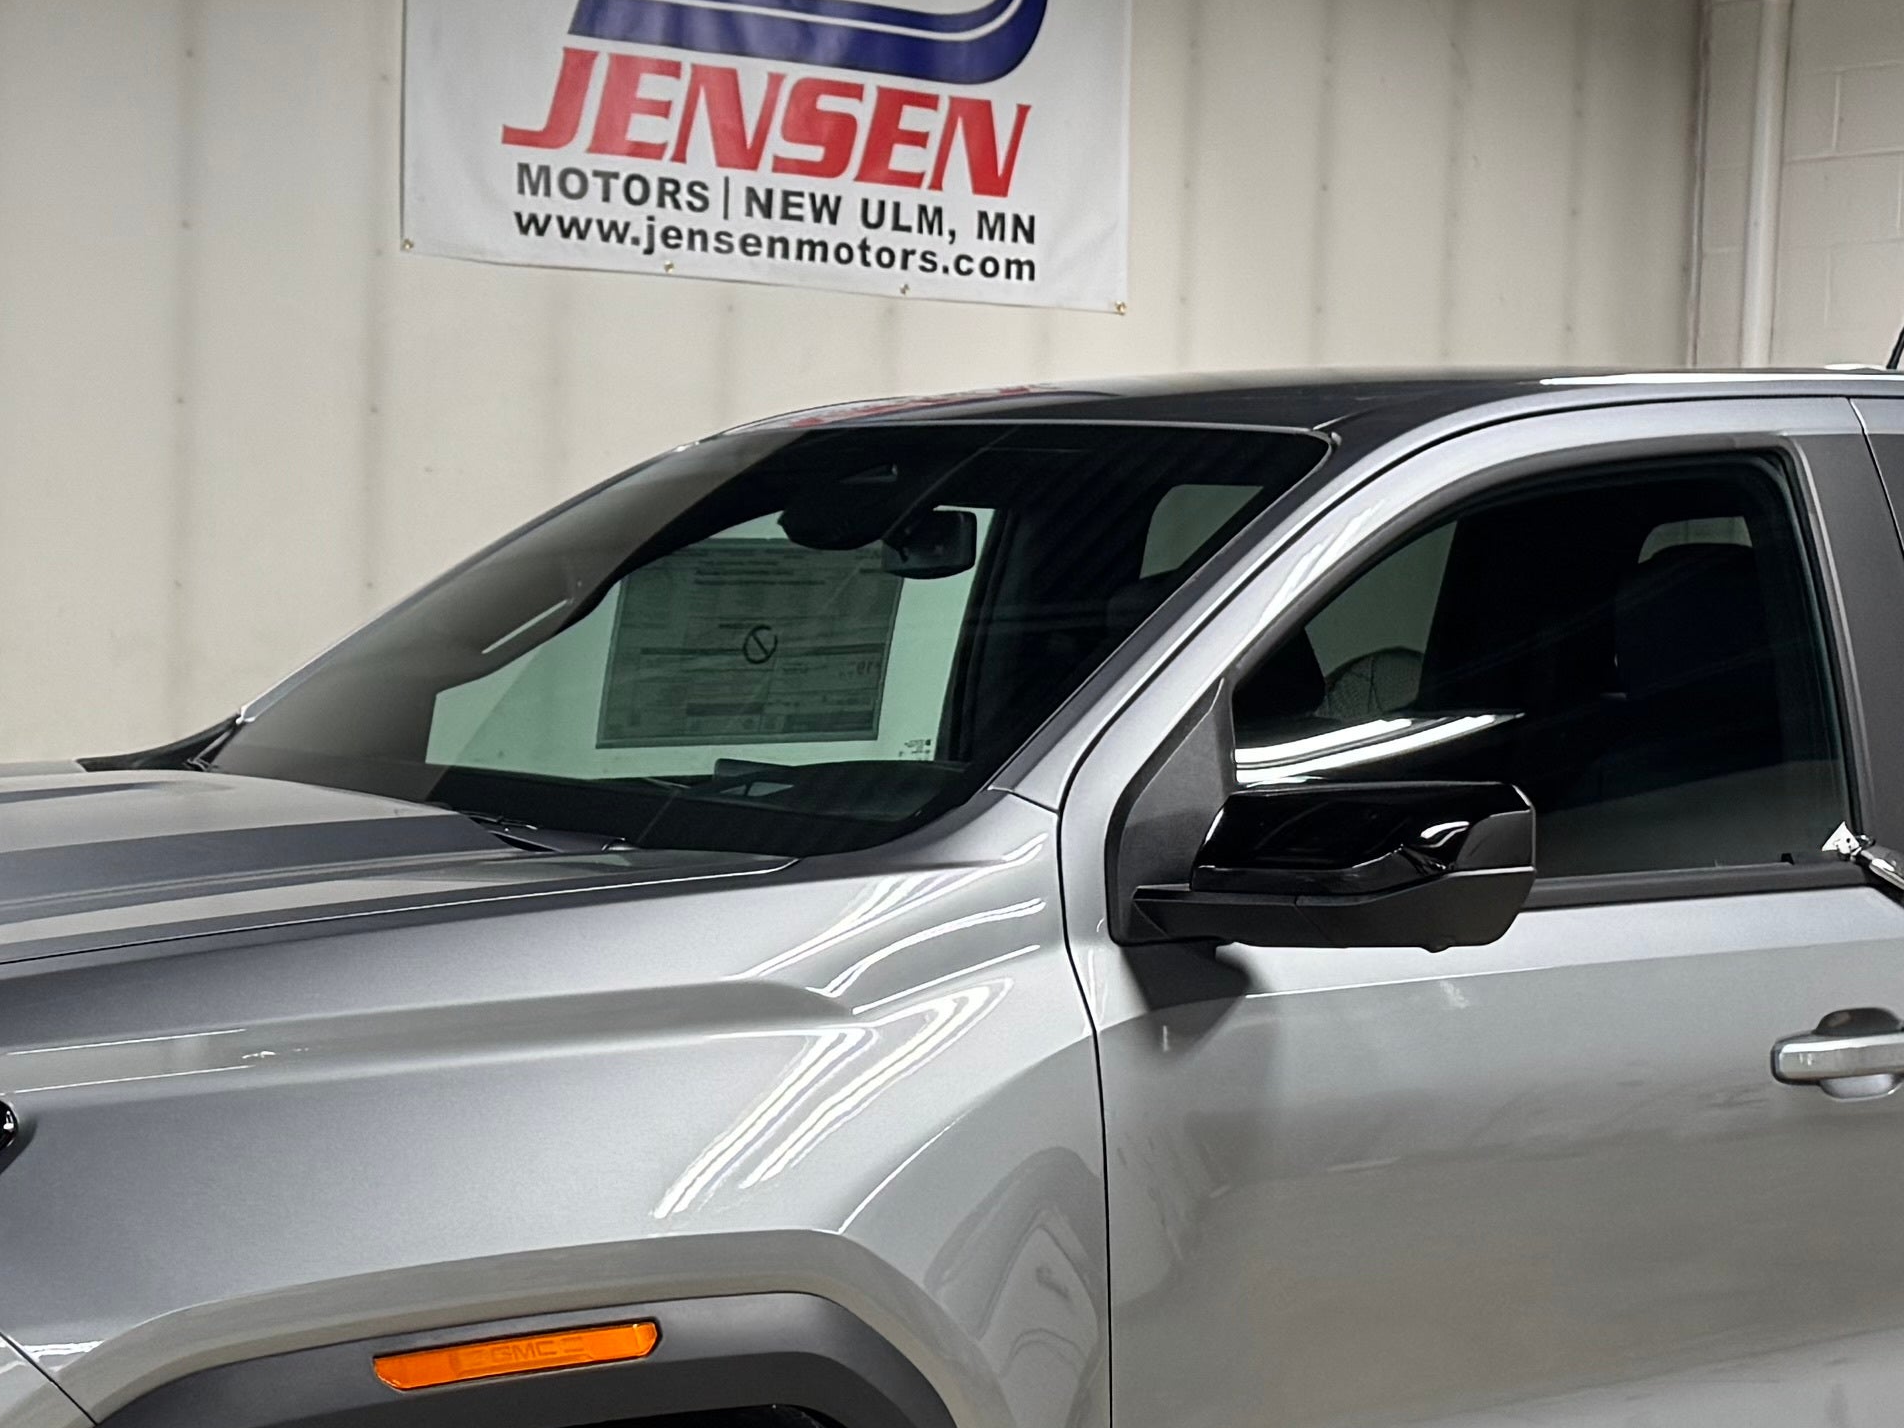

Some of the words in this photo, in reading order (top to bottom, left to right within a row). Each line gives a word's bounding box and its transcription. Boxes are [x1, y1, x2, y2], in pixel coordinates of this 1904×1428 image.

[502, 47, 1031, 197] JENSEN
[516, 162, 709, 212] MOTORS
[746, 187, 841, 224] NEW
[861, 197, 957, 244] ULM,
[977, 211, 1036, 244] MN
[514, 209, 1037, 282] www.jensenmotors.com
